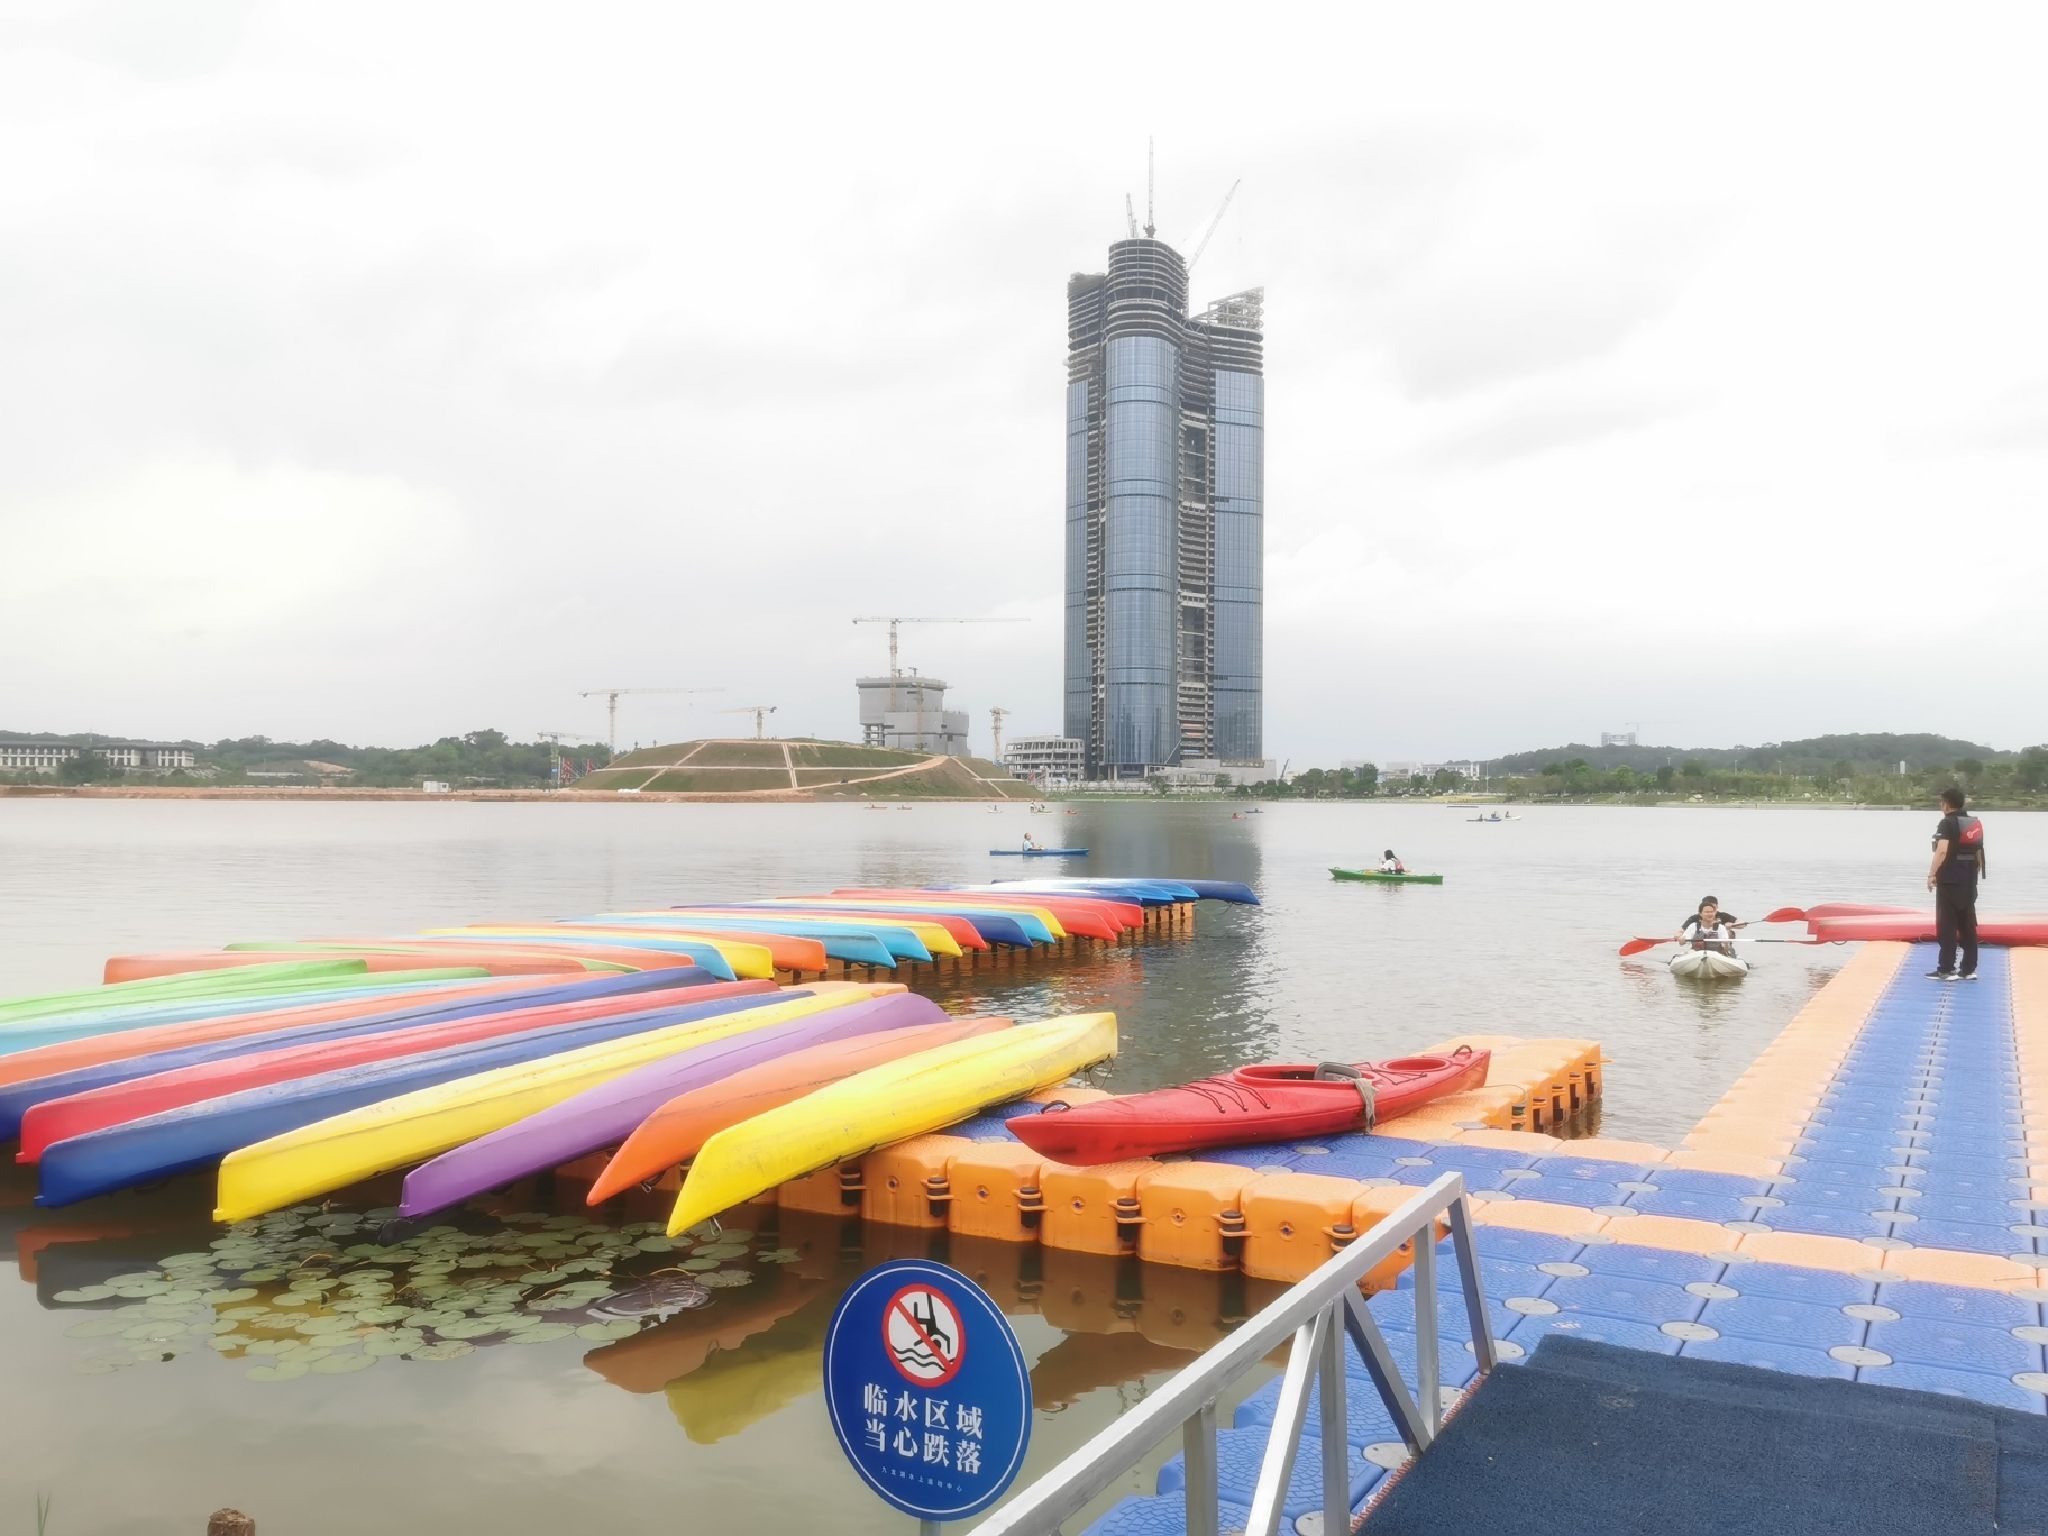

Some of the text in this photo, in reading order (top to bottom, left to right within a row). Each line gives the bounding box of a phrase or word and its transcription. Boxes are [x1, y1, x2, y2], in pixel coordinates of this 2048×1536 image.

[864, 1383, 982, 1439] 临水区域
[865, 1419, 981, 1474] 当心跌落
